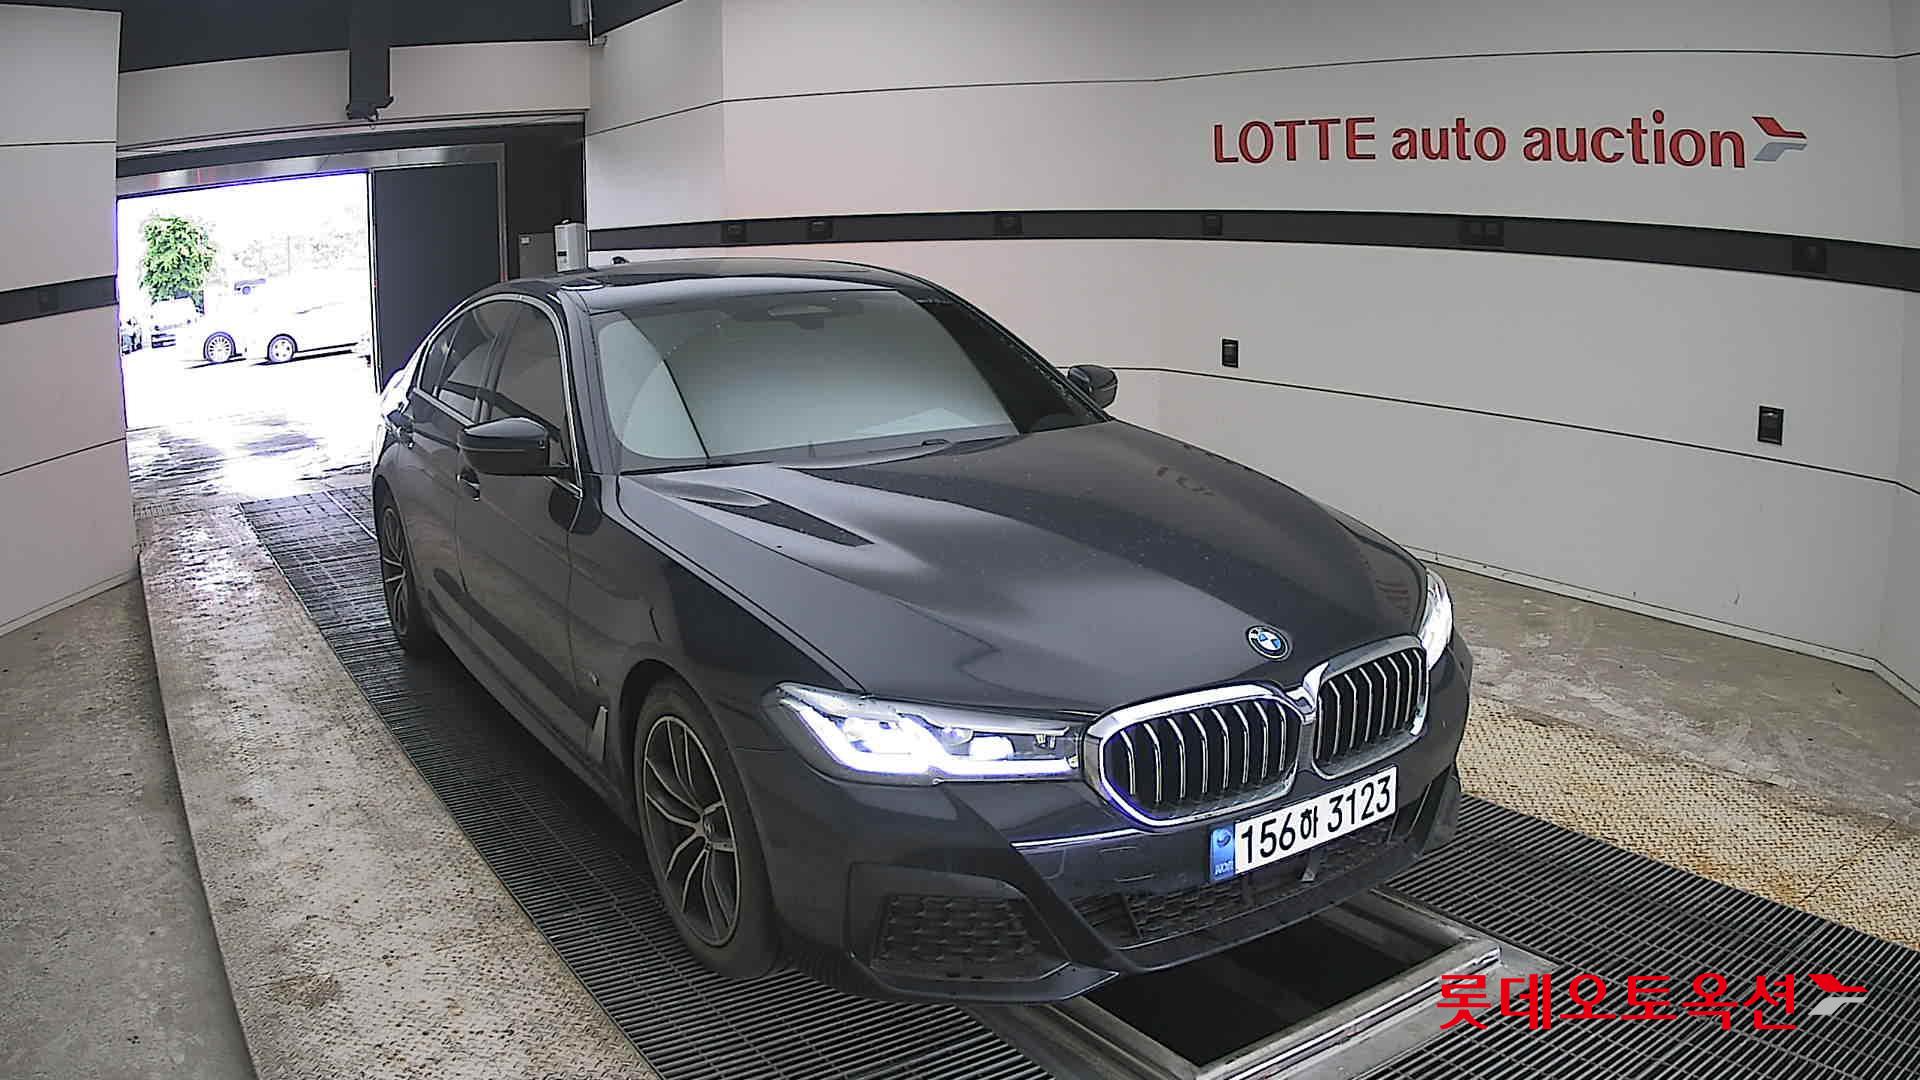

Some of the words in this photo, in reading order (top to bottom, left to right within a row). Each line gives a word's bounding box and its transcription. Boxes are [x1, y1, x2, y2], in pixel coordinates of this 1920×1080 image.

[1213, 116, 1376, 164] LOTTE
[1391, 118, 1507, 161] auto
[1522, 109, 1746, 168] auction
[1241, 805, 1319, 863] 156하
[1327, 775, 1391, 833] 3123
